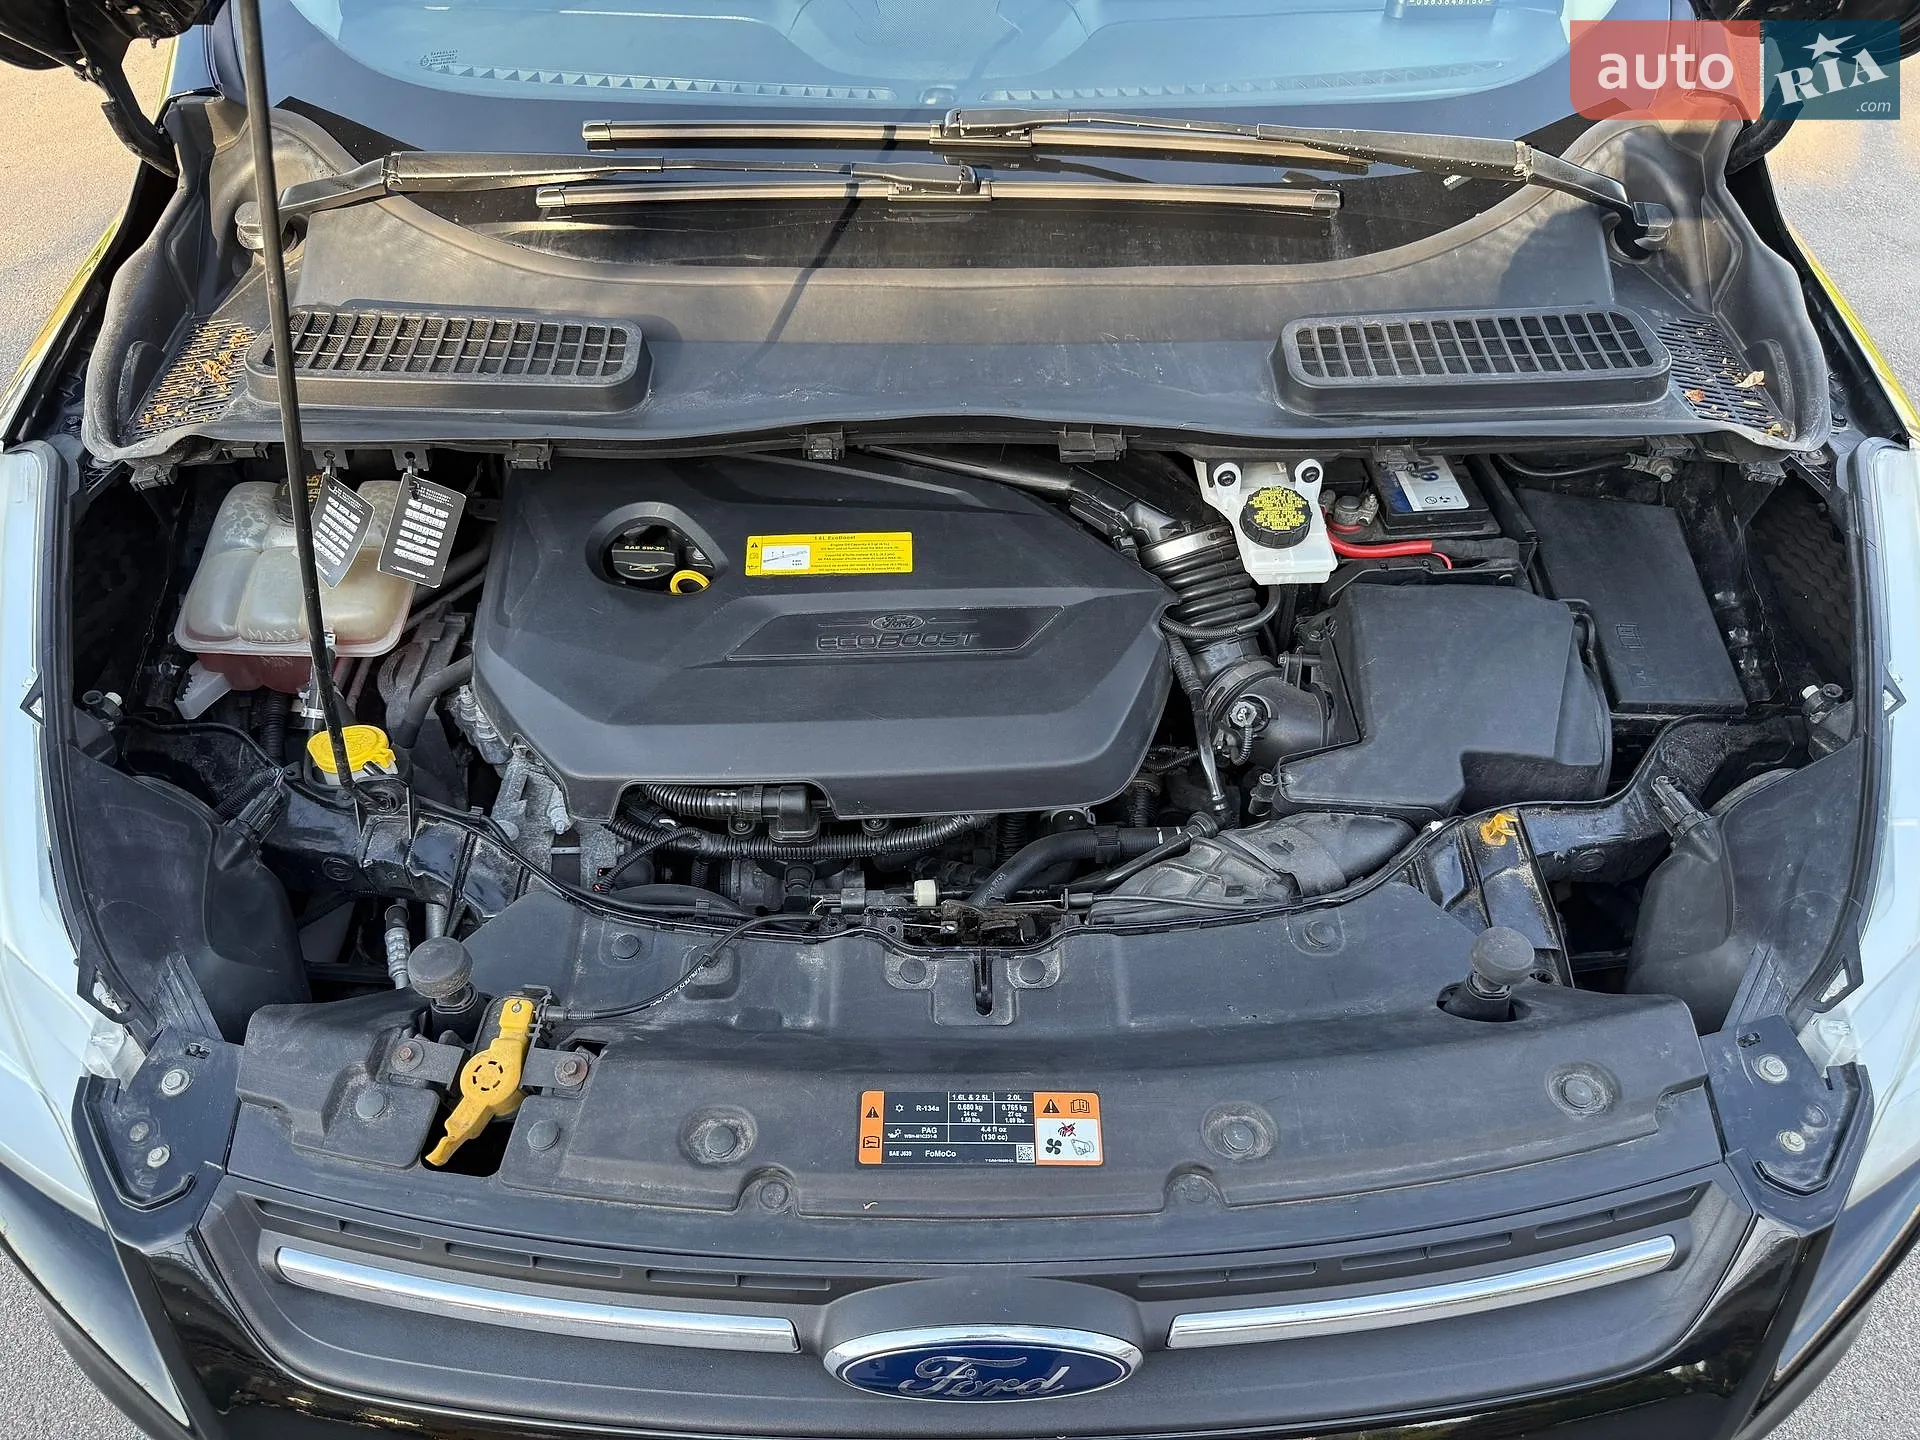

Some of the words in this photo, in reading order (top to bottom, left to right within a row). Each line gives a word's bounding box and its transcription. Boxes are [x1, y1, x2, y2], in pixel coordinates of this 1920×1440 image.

[974, 1103, 983, 1112] kg
[1019, 1104, 1028, 1113] kg
[981, 1133, 996, 1141] (130
[997, 1133, 1008, 1141] cc)
[925, 1149, 957, 1158] FoMoCo
[897, 1355, 1071, 1397] Ford
